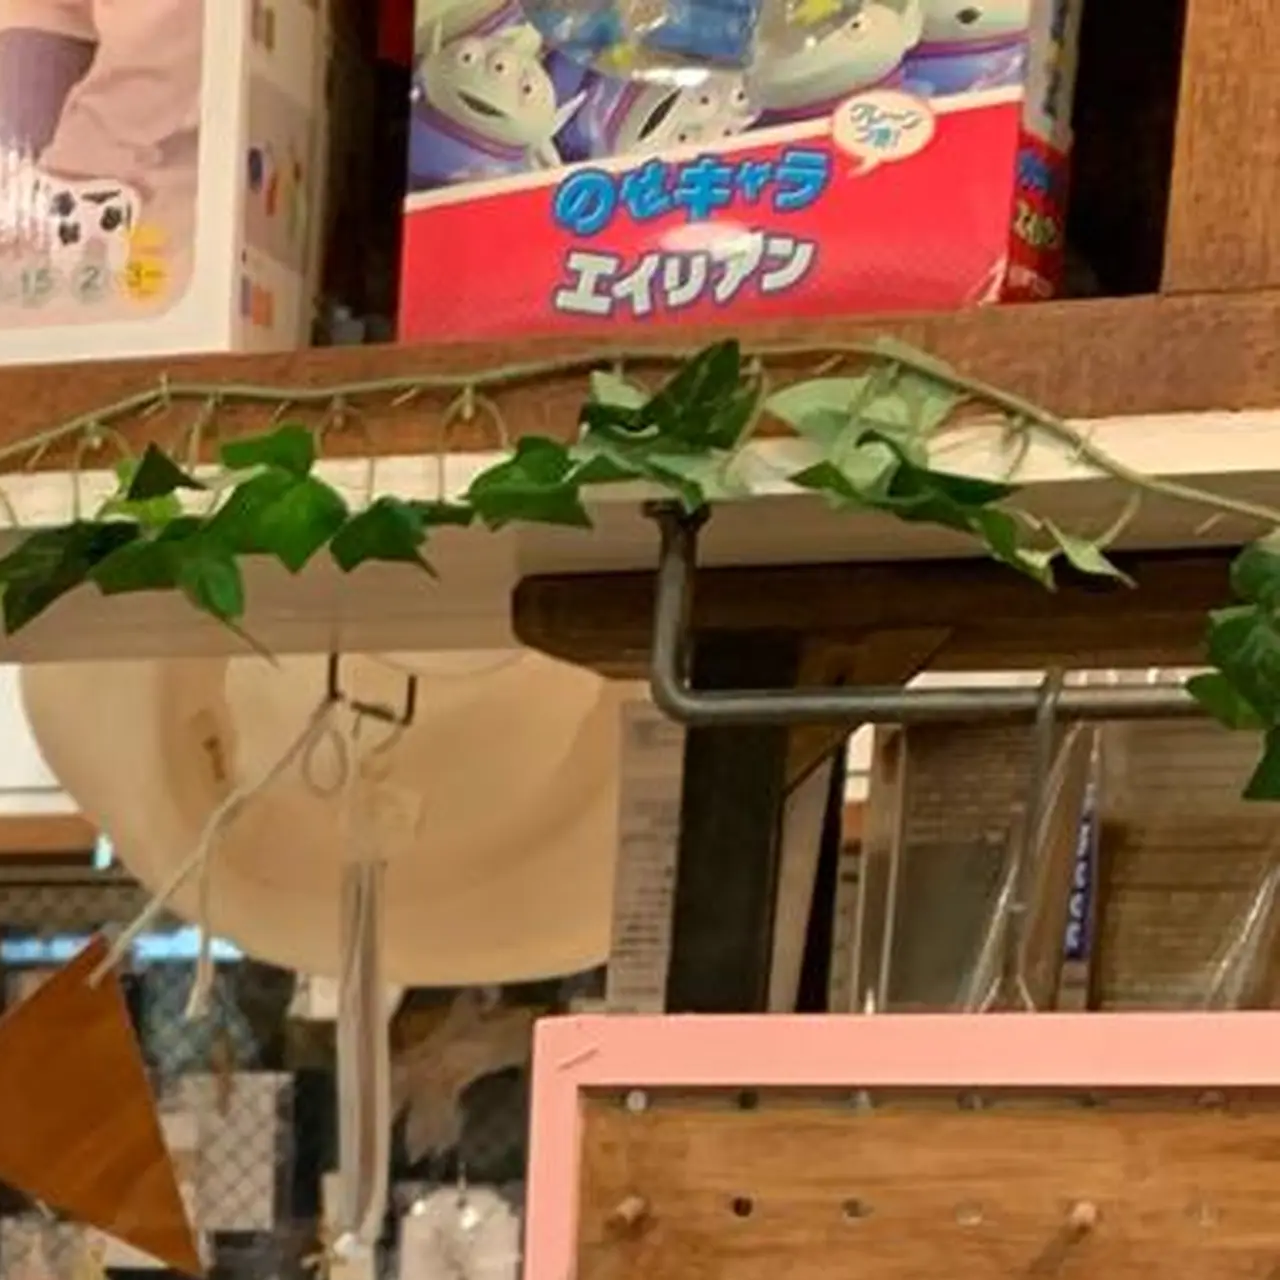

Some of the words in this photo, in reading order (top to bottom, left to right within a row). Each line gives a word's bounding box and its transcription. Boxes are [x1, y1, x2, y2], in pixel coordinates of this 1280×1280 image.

[554, 146, 832, 236] のせキャラ
[553, 230, 816, 316] エイリアン
